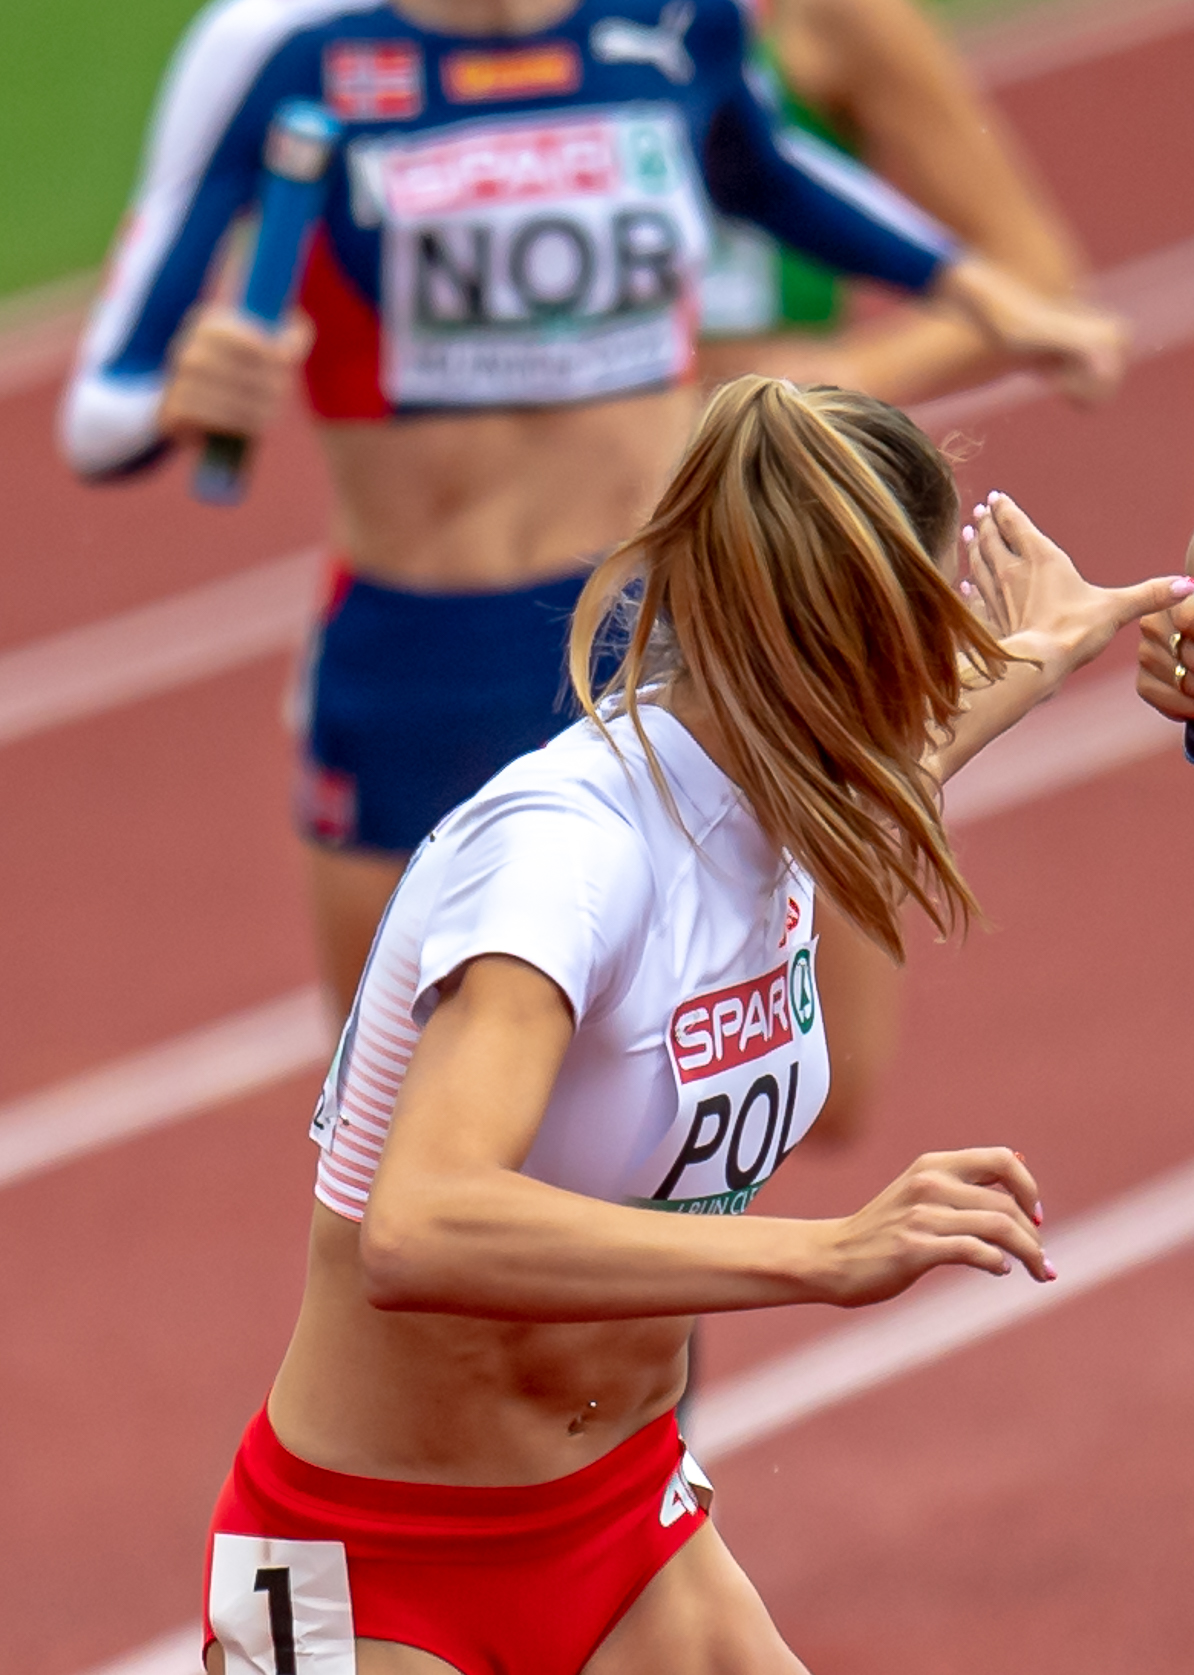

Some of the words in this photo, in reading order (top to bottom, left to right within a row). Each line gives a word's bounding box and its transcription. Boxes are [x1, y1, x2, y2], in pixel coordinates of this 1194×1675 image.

[413, 211, 681, 323] NOR
[674, 974, 789, 1071] SPAR
[253, 1565, 297, 1675] 1
